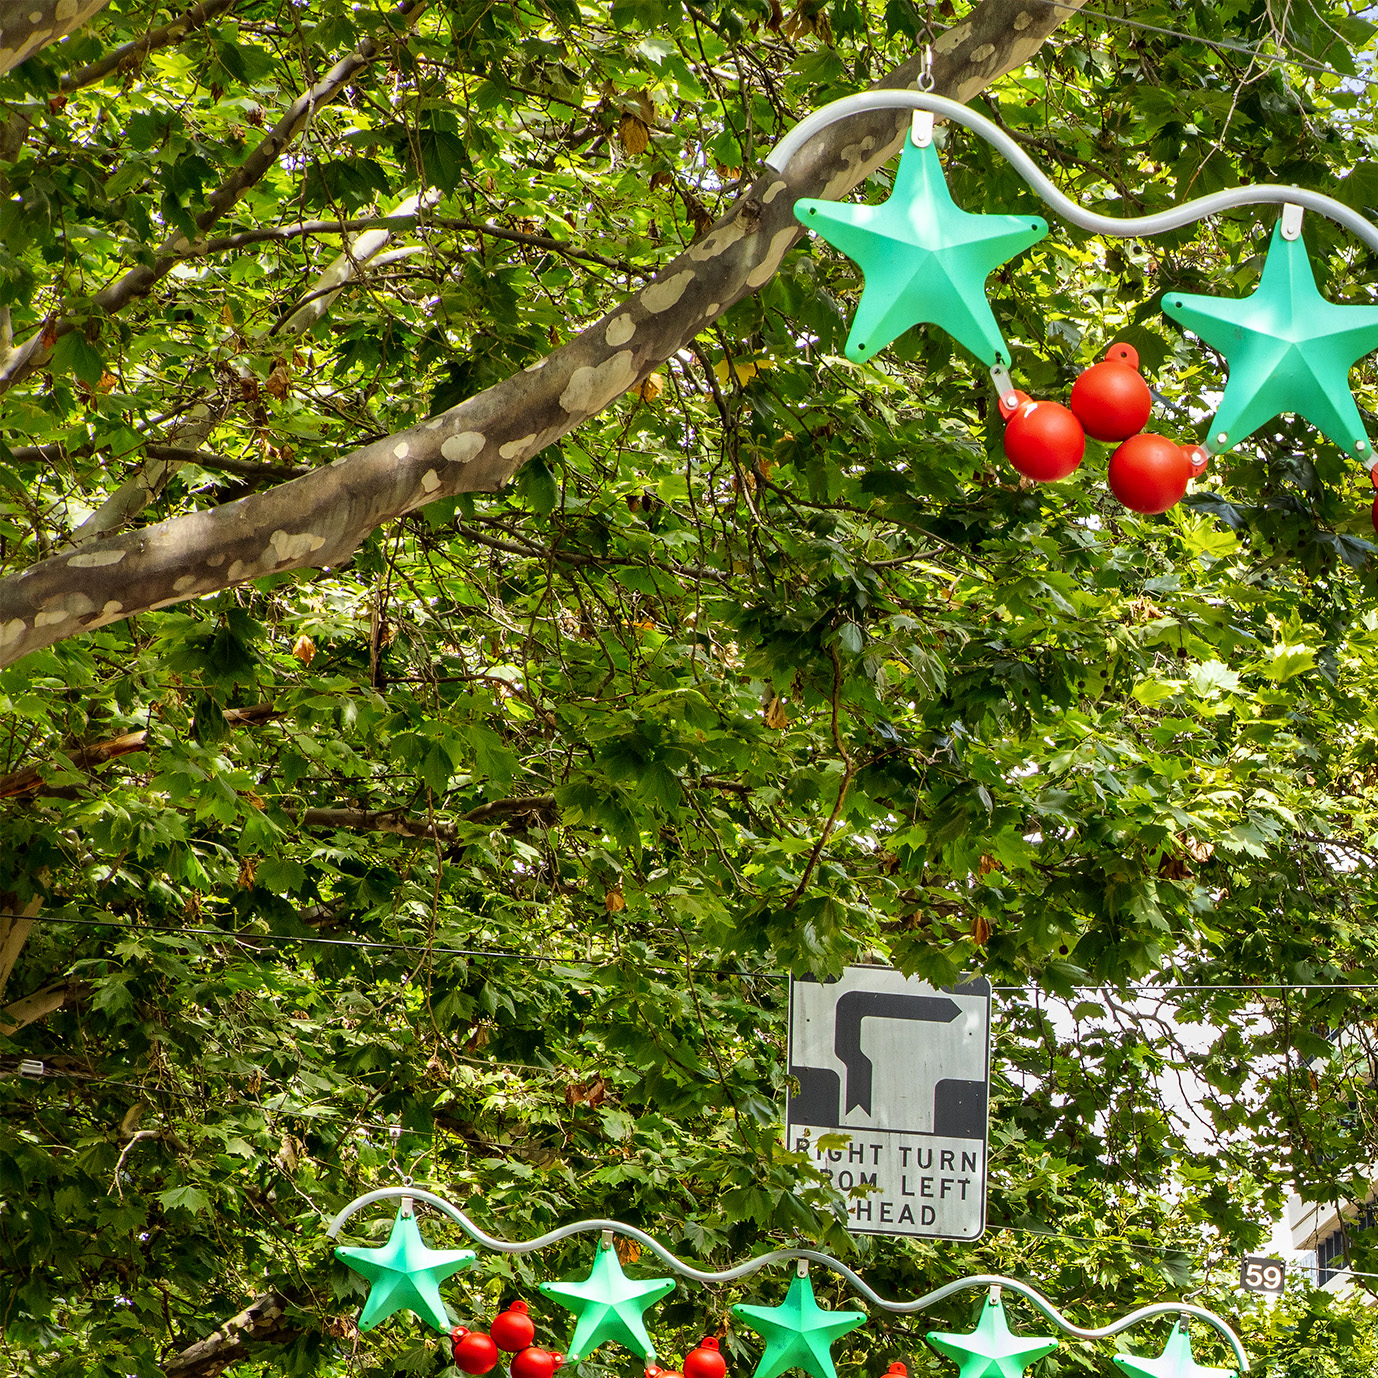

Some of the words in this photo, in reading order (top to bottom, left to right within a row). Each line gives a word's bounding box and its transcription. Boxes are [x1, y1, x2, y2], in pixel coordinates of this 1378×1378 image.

[899, 1146, 977, 1173] TURN
[901, 1175, 971, 1200] LEFT
[855, 1200, 937, 1225] HEAD
[1245, 1263, 1282, 1289] 59
